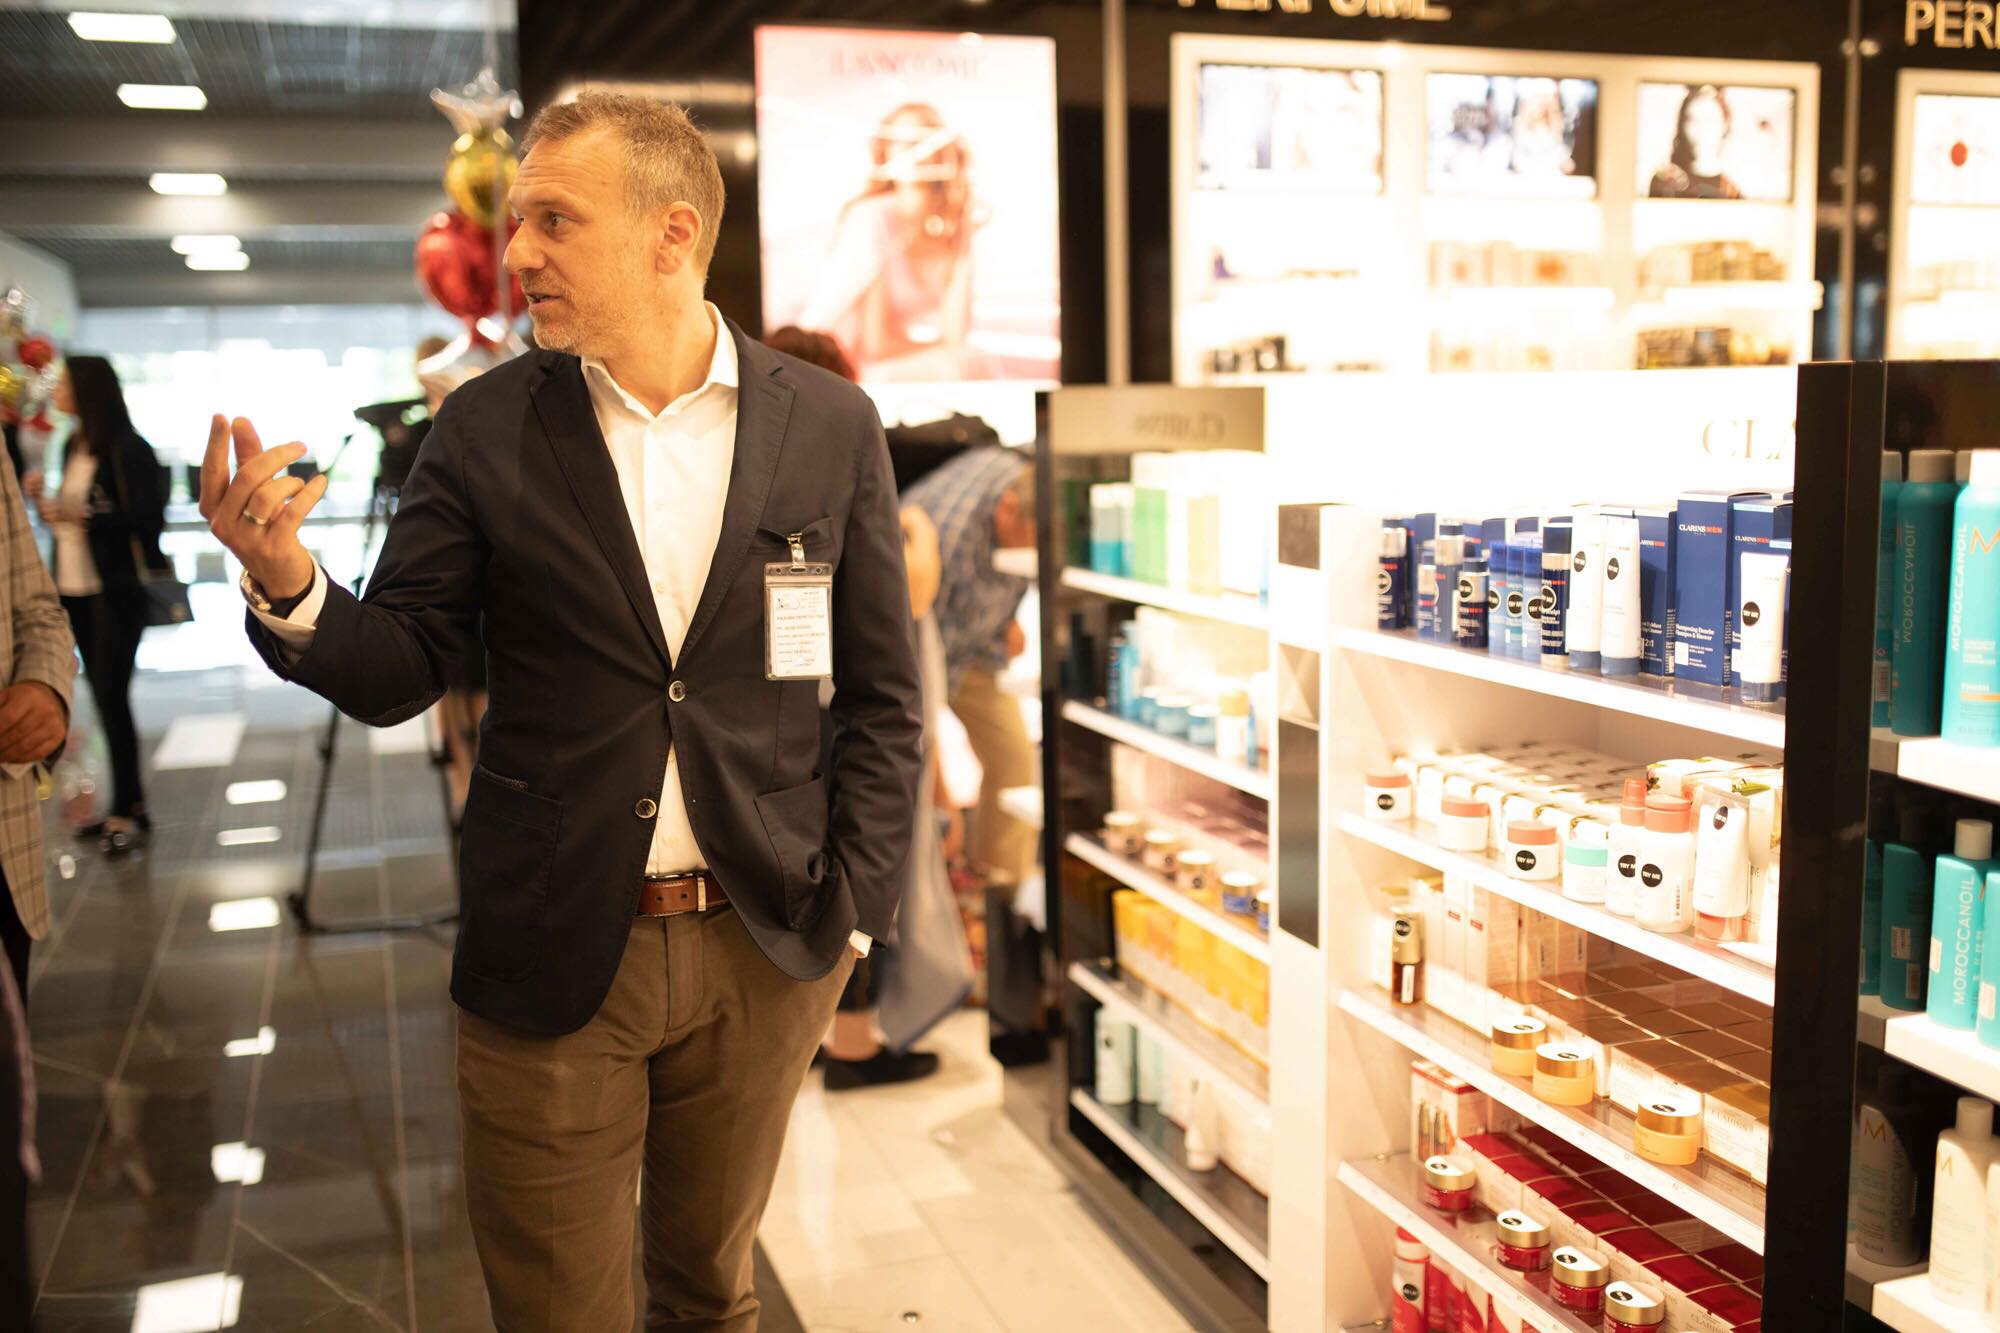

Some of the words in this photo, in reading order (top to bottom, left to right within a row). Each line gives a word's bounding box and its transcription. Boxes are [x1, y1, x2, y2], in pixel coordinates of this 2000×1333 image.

[1904, 0, 2000, 50] PER
[1951, 523, 1968, 651] MOROCCANOIL
[1953, 875, 1975, 1005] MOROCCANOIL
